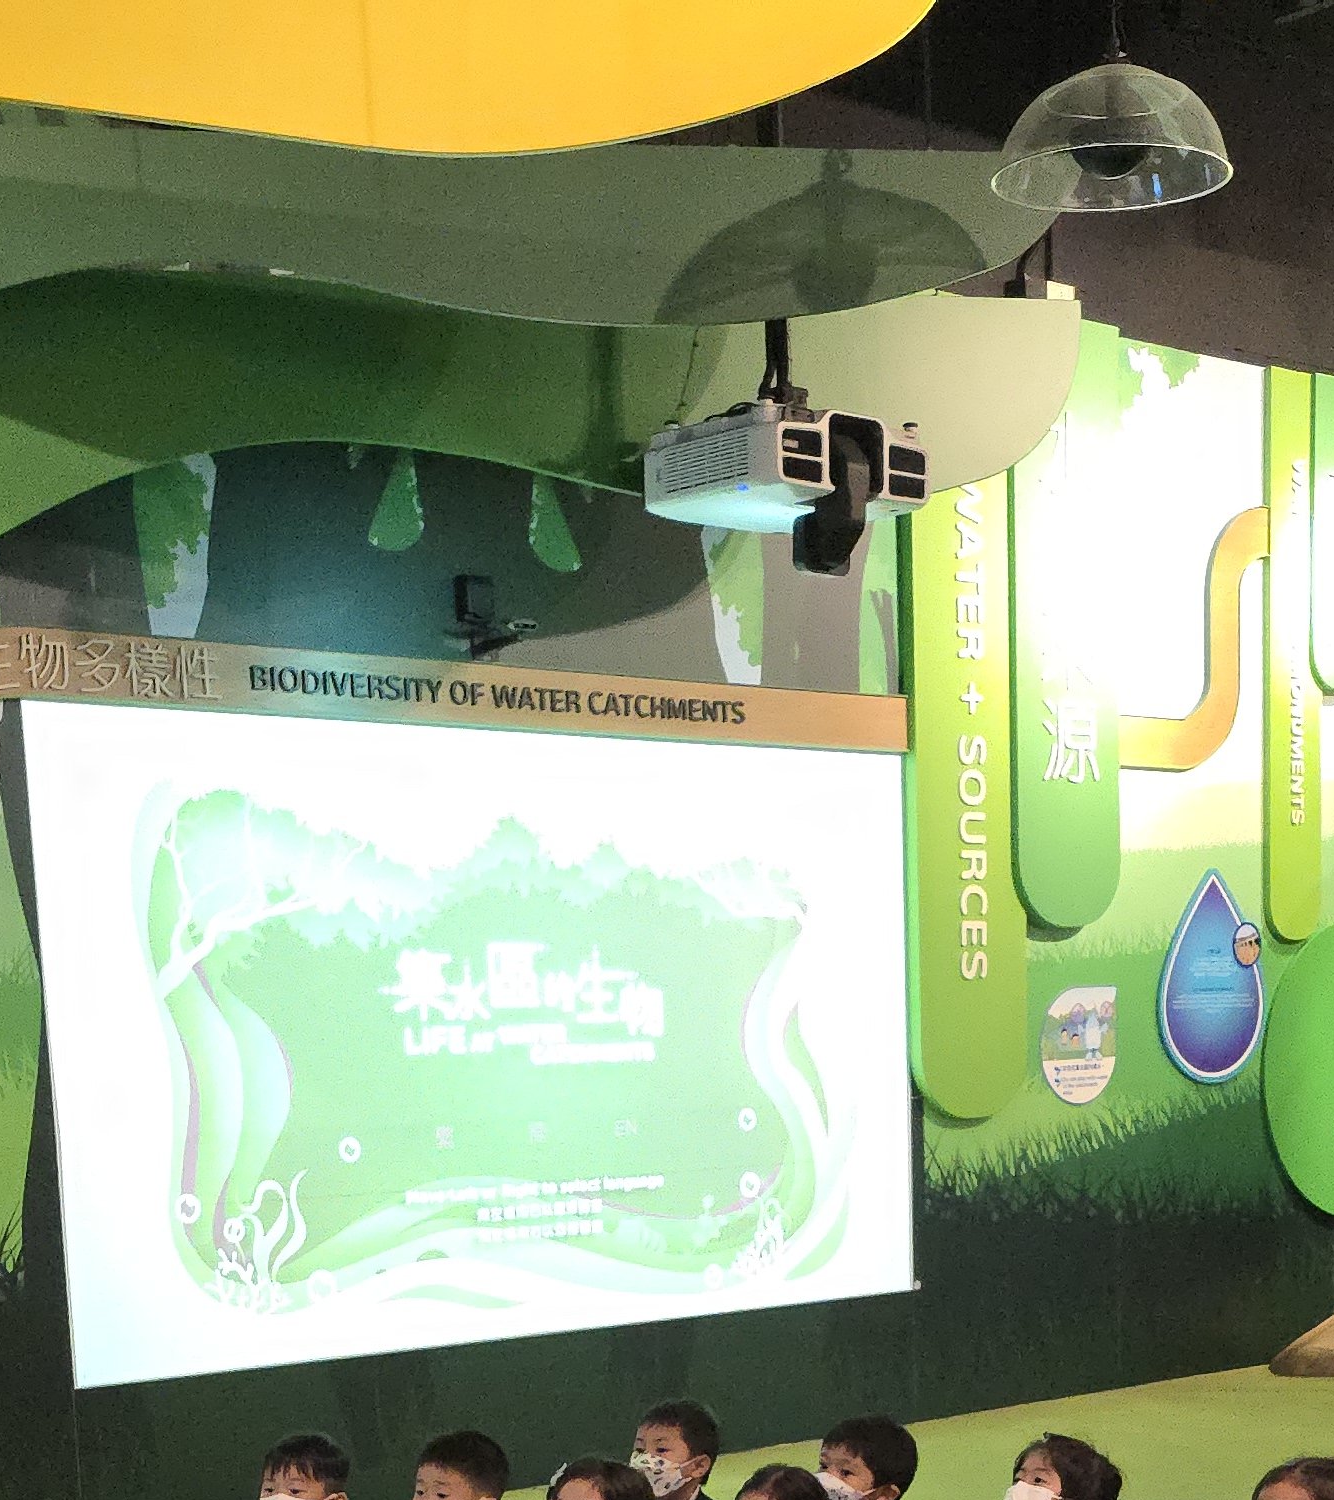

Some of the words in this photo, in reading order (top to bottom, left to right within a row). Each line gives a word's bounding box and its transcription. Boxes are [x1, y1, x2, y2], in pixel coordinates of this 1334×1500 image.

[954, 484, 985, 660] WATER
[248, 664, 444, 706] BIODIVERSITY
[450, 679, 487, 707] OF
[490, 684, 582, 715] WATER
[587, 692, 746, 726] CATCHMENTS
[956, 733, 989, 982] SOURCES
[404, 1025, 468, 1055] LIFE
